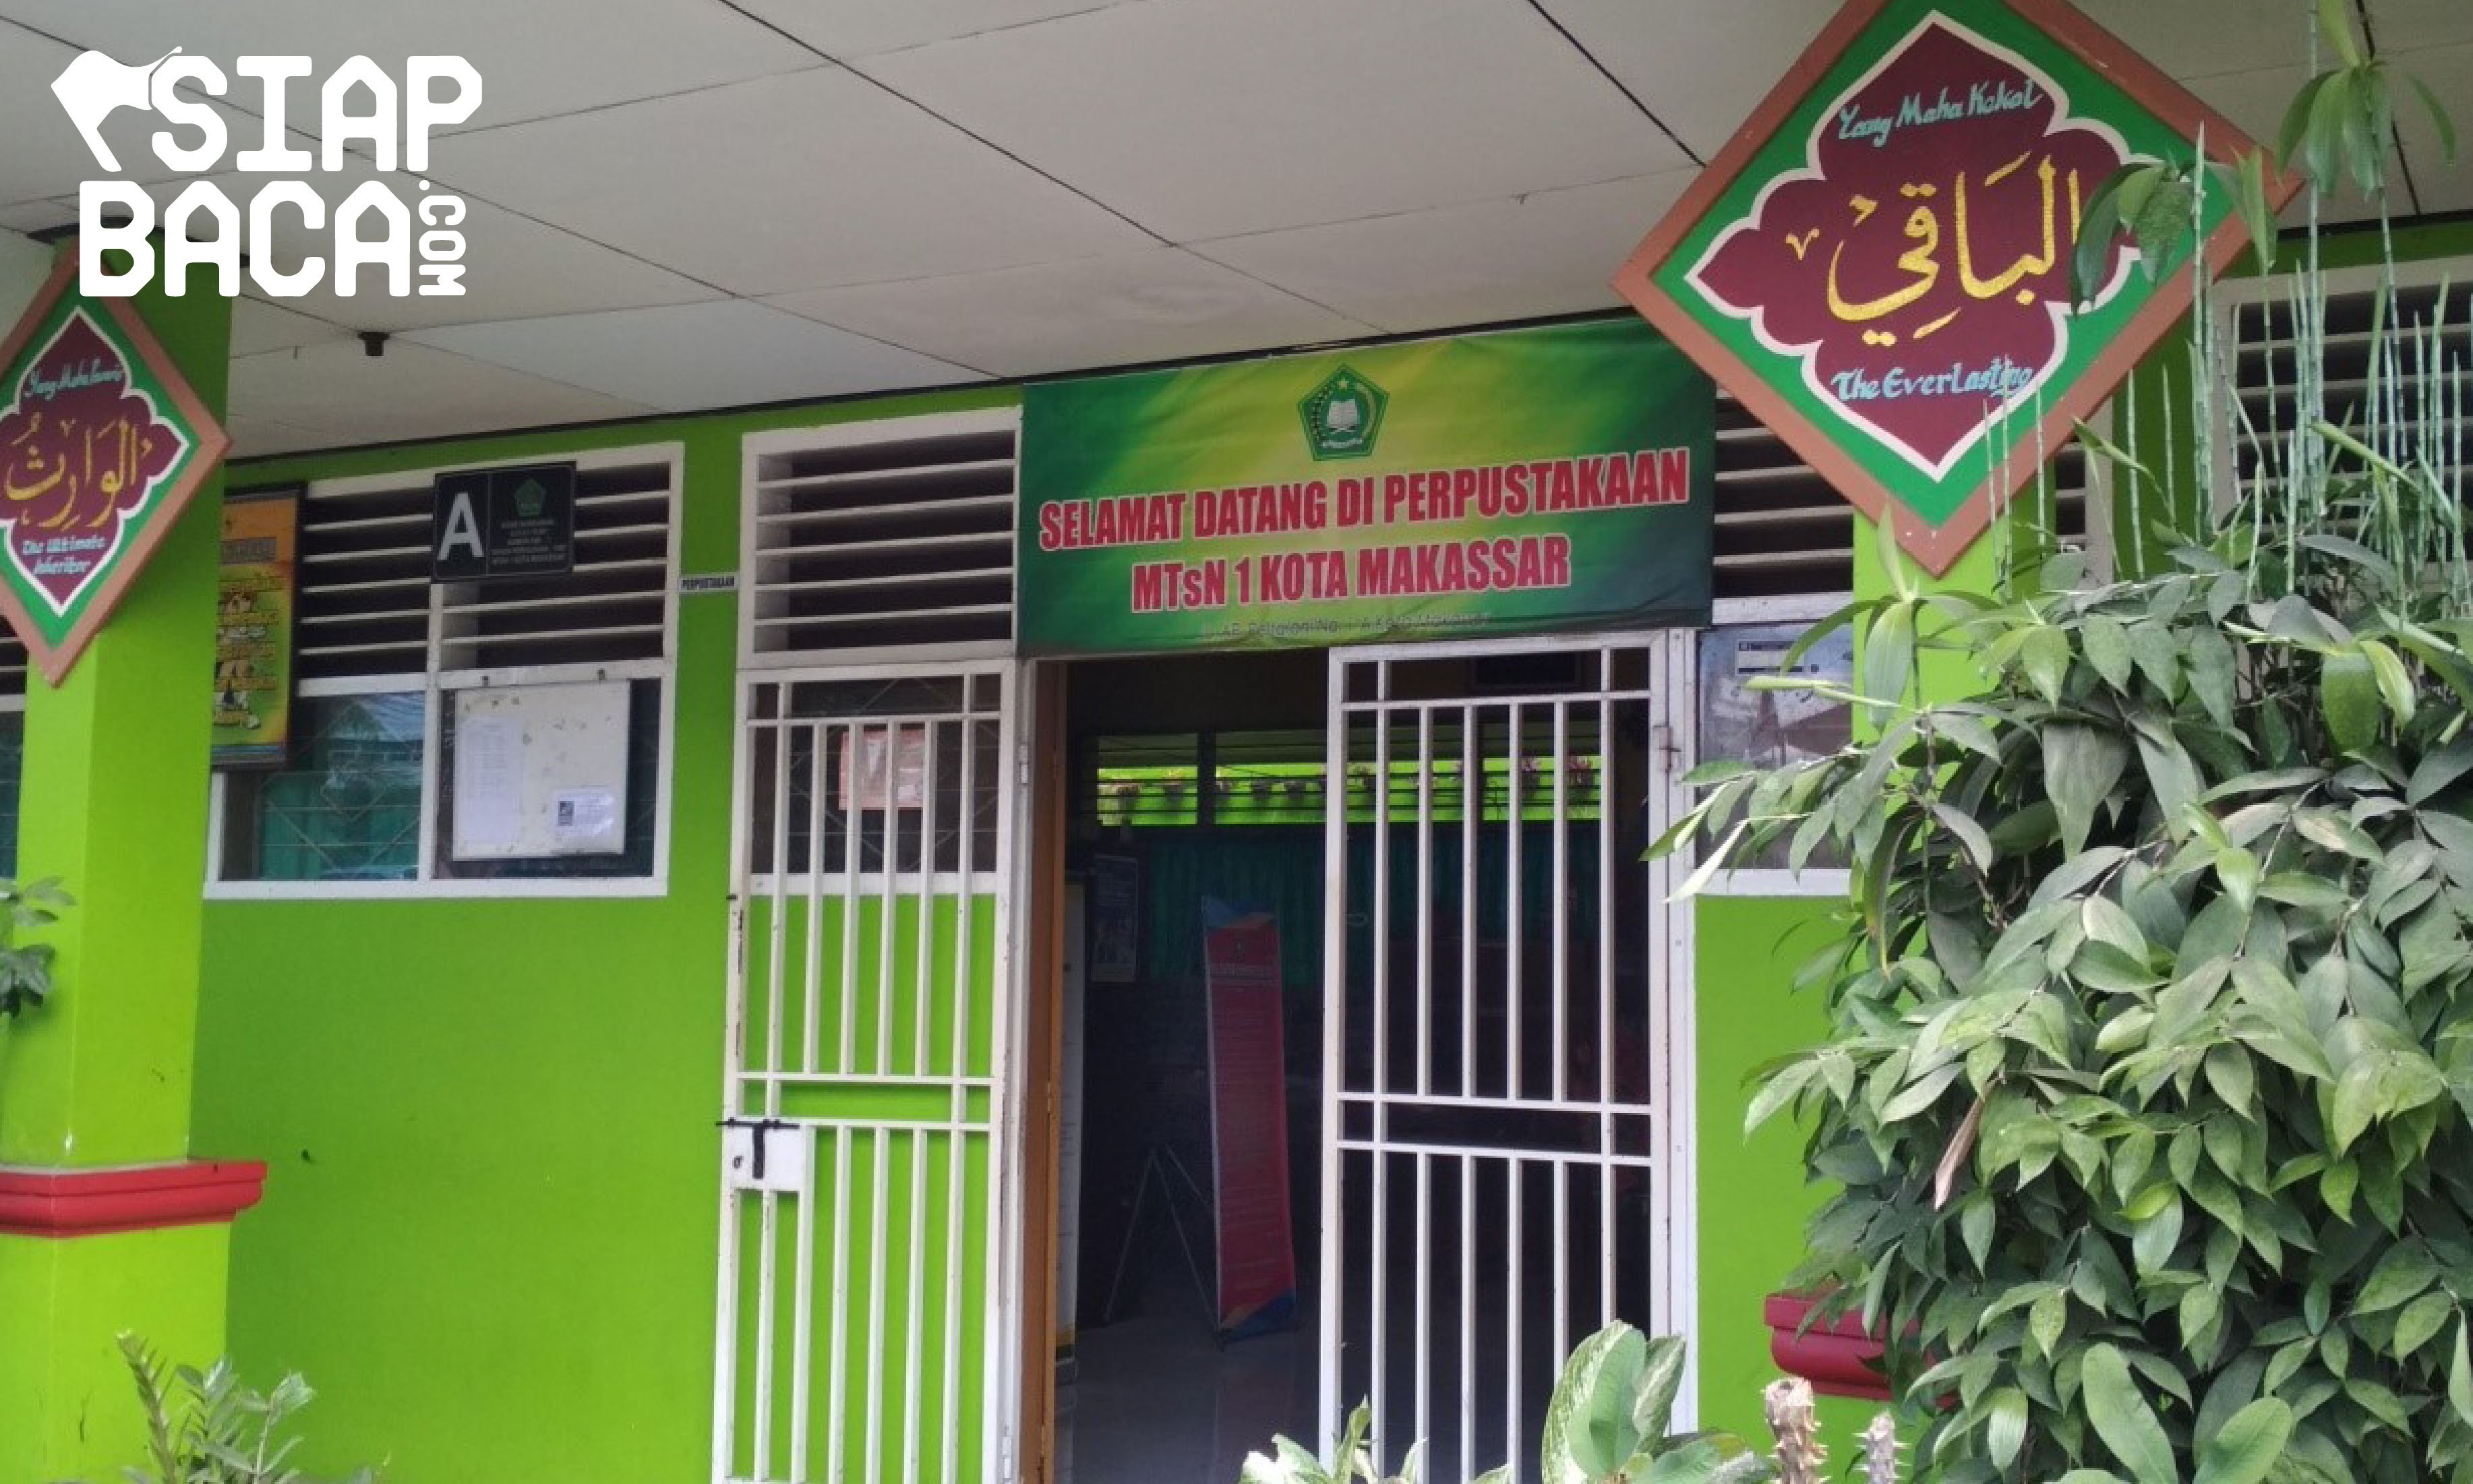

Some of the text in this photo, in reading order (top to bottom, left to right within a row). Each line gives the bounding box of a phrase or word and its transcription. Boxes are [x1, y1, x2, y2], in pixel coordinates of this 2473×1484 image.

[1839, 104, 1893, 147] Yang
[1895, 86, 1963, 128] Maha
[1831, 368, 1880, 400] The
[437, 493, 485, 561] A
[1040, 446, 1690, 551] SELAMAT DATANG DI PERPUSTAKAAN
[1131, 533, 1572, 613] MTsN 1 KOTA MAKASSAR
